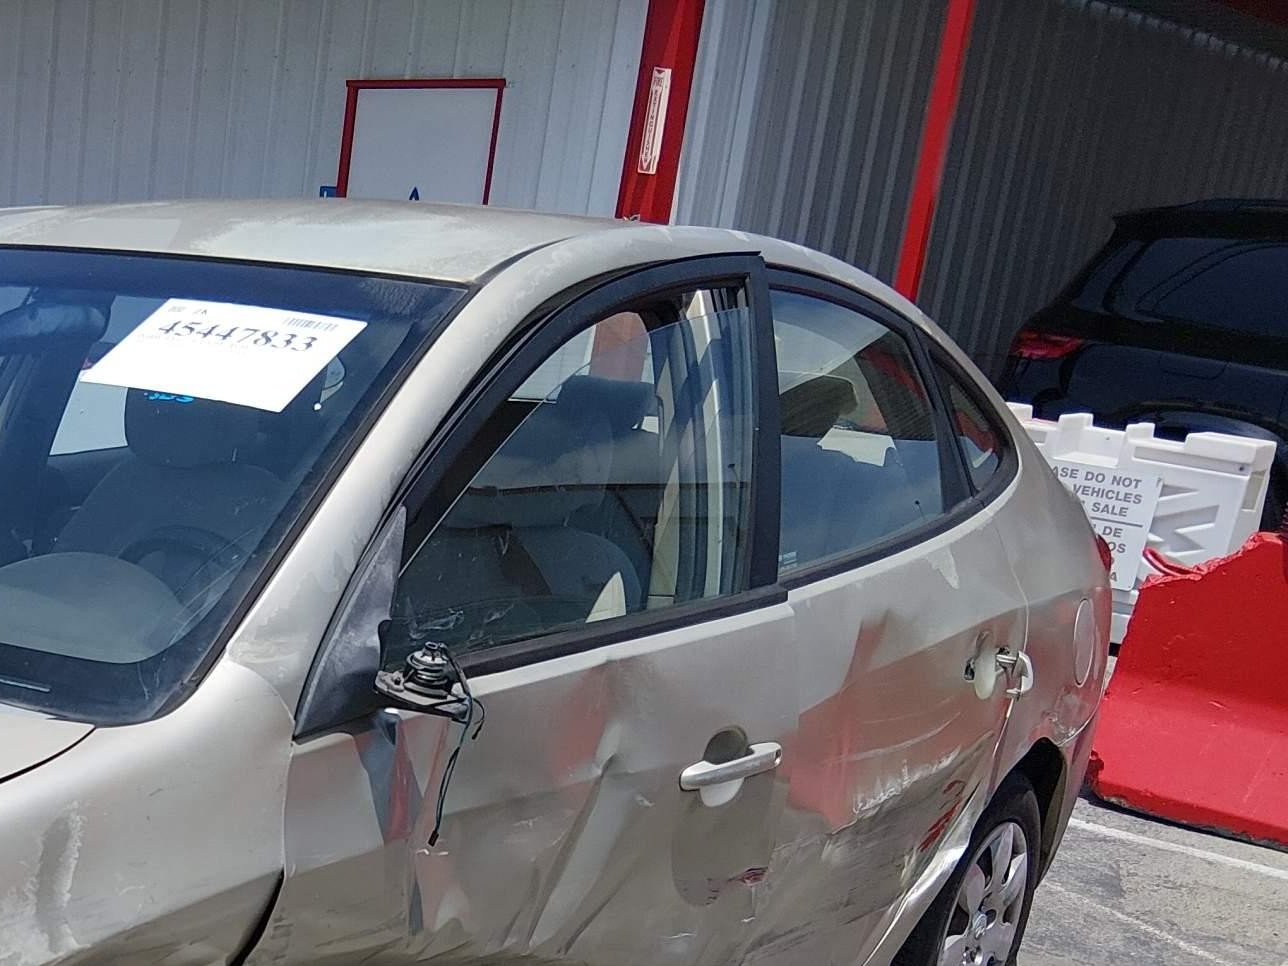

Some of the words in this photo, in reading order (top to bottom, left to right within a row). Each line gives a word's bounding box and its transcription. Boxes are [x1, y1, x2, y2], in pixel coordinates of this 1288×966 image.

[158, 319, 318, 352] 45447833
[1084, 471, 1106, 484] DO
[1111, 475, 1142, 489] NOT
[1072, 484, 1143, 505] VEHICLES
[1091, 502, 1129, 517] SALE
[1102, 525, 1124, 538] DE
